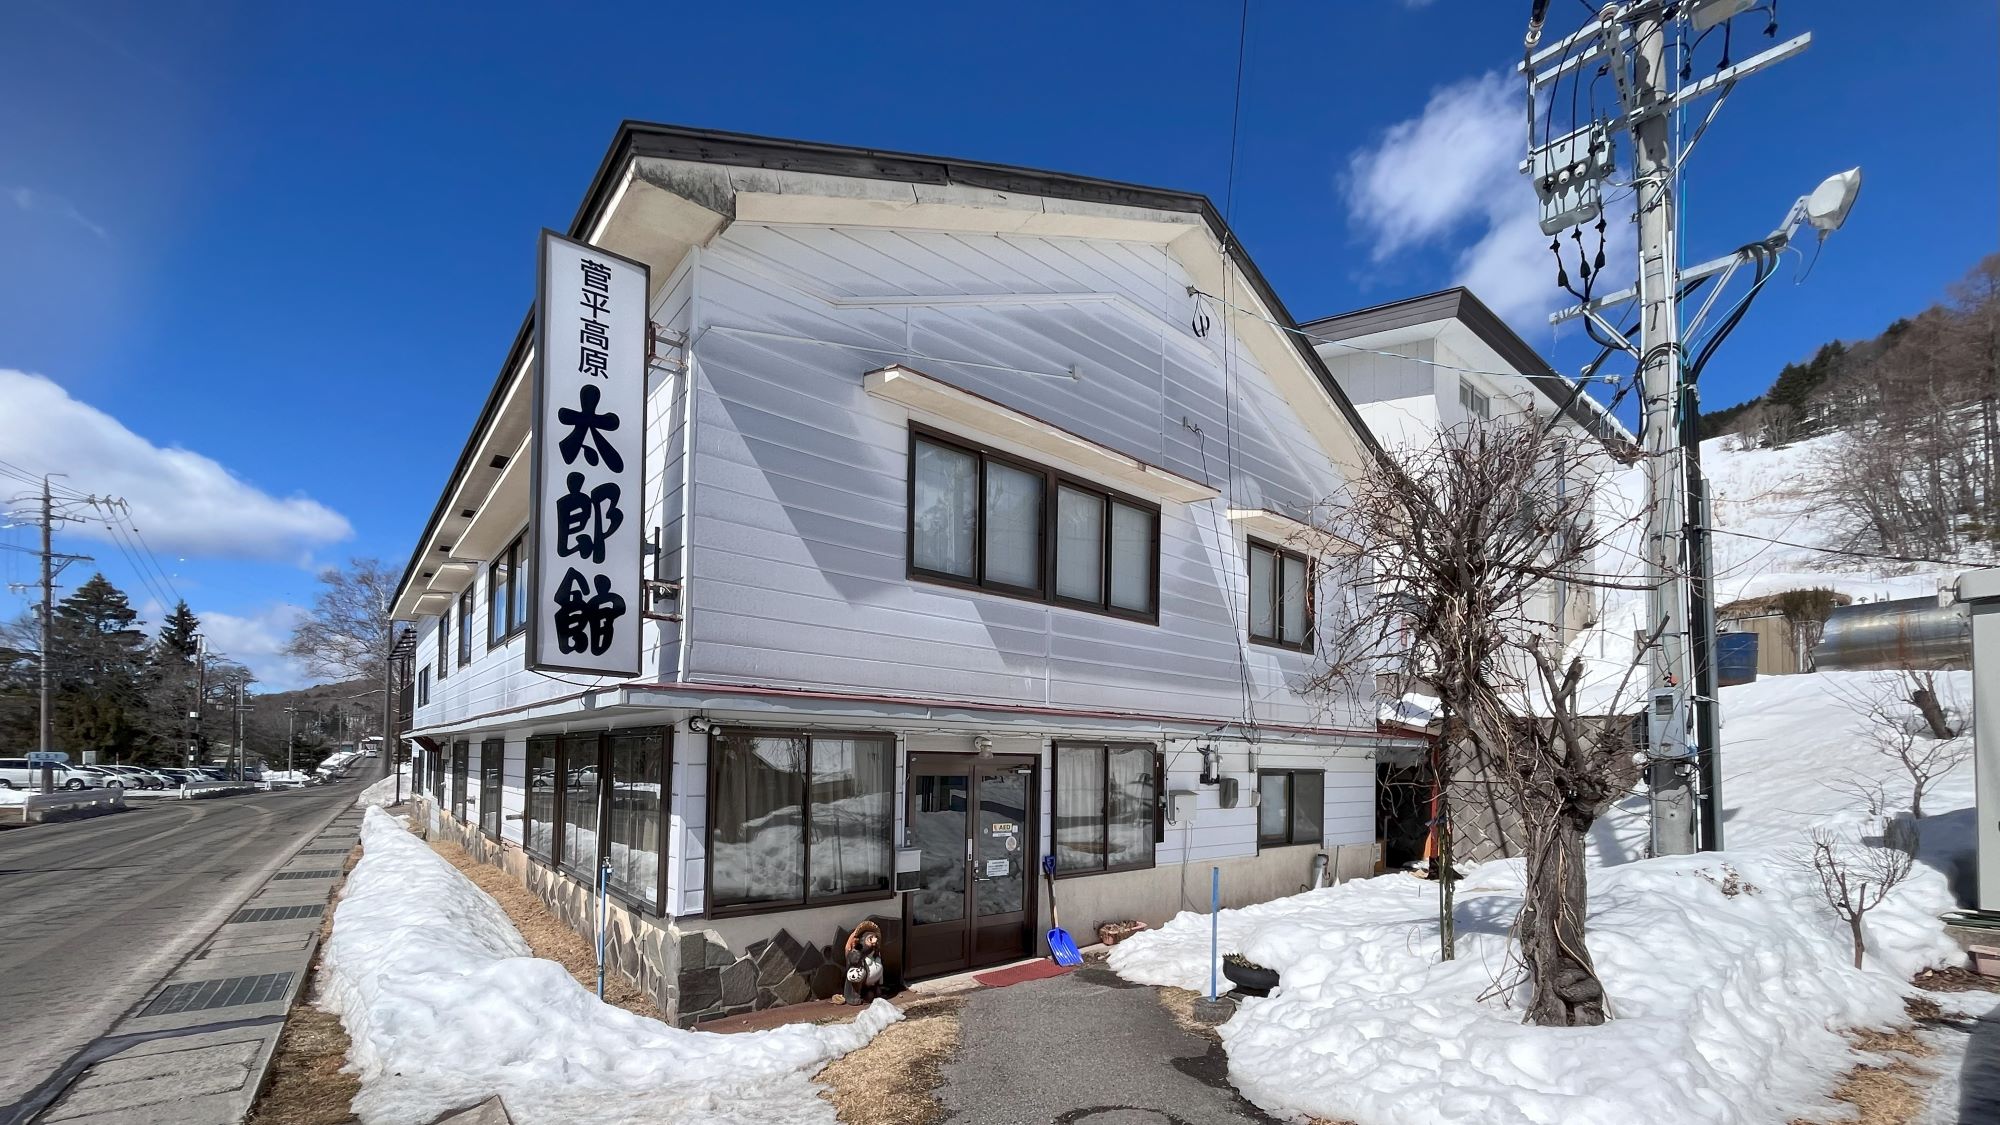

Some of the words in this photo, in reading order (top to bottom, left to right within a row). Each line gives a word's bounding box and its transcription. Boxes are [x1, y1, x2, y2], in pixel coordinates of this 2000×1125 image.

[578, 258, 612, 380] 菅平高原
[554, 384, 627, 656] 太郎館
